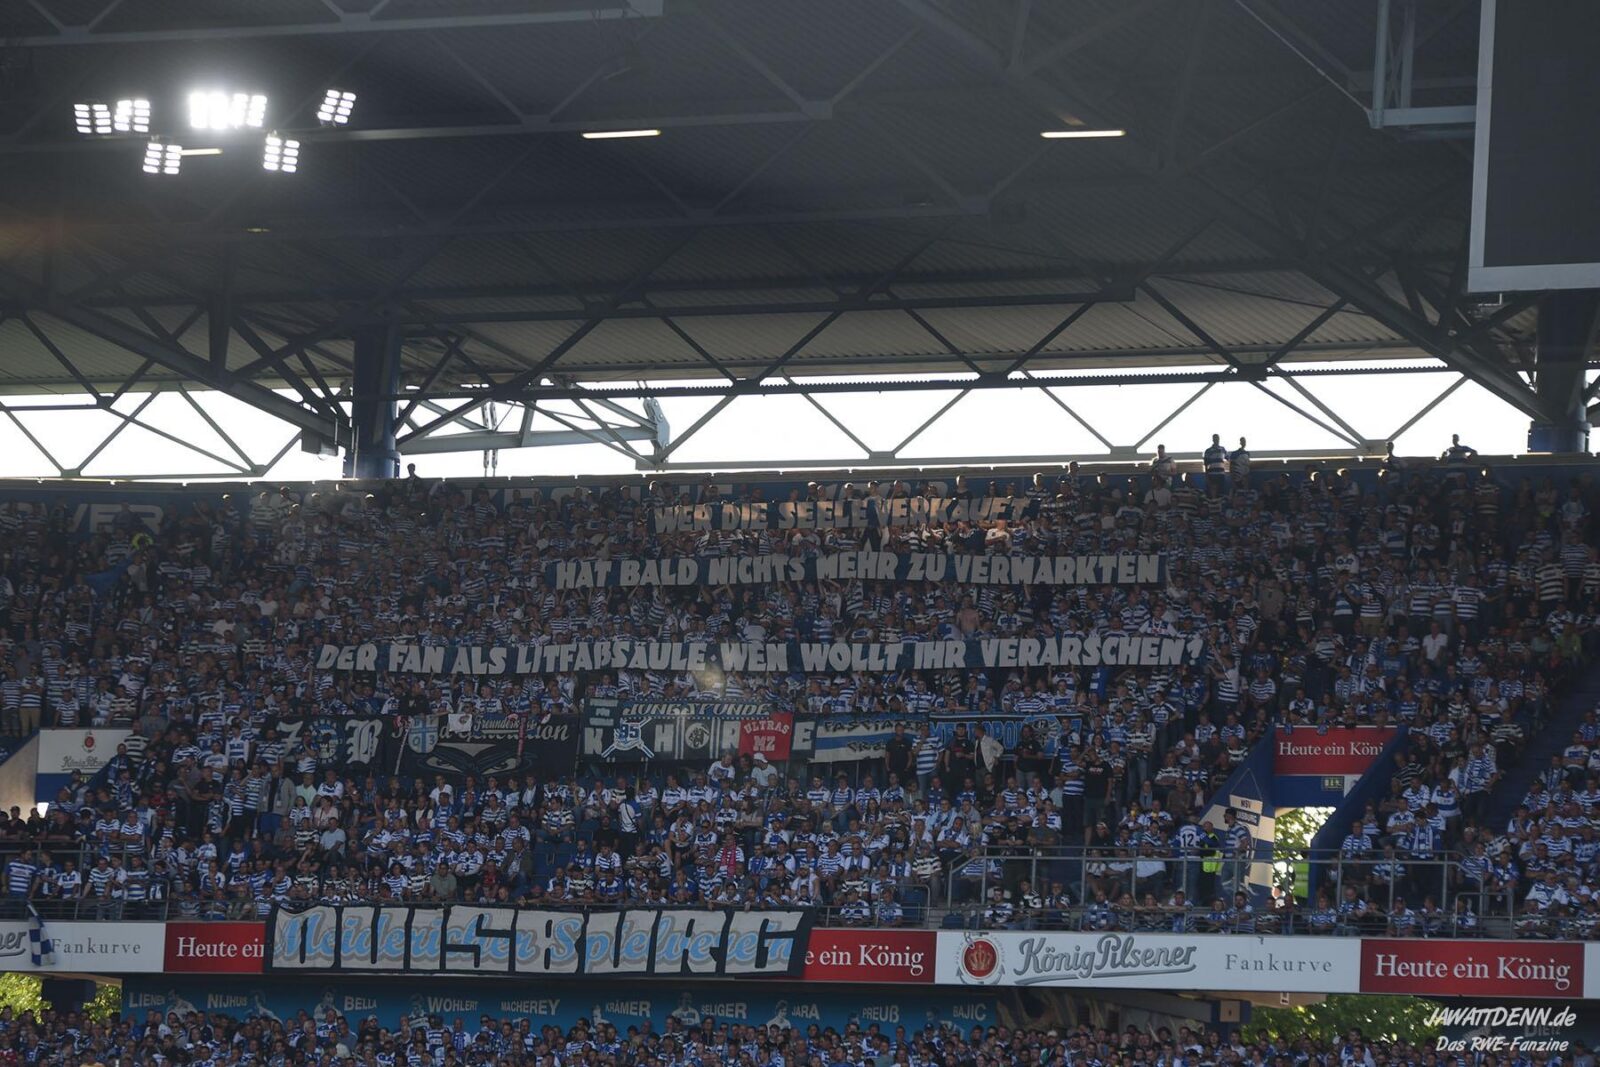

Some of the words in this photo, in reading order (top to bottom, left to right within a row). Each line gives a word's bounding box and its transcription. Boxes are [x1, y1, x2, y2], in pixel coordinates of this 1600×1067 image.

[655, 505, 712, 534] WER
[721, 503, 768, 530] DIE
[779, 499, 868, 529] SEELE
[877, 496, 1030, 526] VERKAUFT
[556, 559, 611, 589] HAT
[619, 558, 698, 586] BALD
[708, 553, 806, 585] NICHTS
[816, 550, 898, 580] MEHR
[906, 553, 946, 581] ZU
[954, 554, 1159, 584] VERMARKTEN
[316, 643, 376, 671] DER
[388, 643, 445, 674] FAN
[451, 644, 507, 675] ALS
[720, 641, 788, 672] WEN
[800, 641, 904, 673] WOLLT
[914, 640, 966, 669] IHR
[981, 636, 1203, 668] VERARSCHEN?
[743, 719, 791, 735] ULTRAS
[753, 735, 776, 752] MZ
[1279, 742, 1321, 756] Heute
[1324, 743, 1345, 756] ein
[1182, 833, 1194, 847] 12
[51, 937, 141, 954] Fankurve
[176, 936, 238, 958] Heute
[272, 905, 804, 974] DUISBURG
[819, 946, 851, 966] ein
[858, 944, 924, 976] König
[1225, 953, 1333, 972] Fankurve
[1375, 954, 1448, 978] Heute
[1453, 957, 1489, 979] ein
[1497, 956, 1571, 990] König
[344, 995, 378, 1011] BELLA
[428, 996, 478, 1013] WOHLERT
[500, 998, 560, 1016] MACHEREY
[605, 998, 652, 1018] KRÄMER
[701, 1002, 748, 1019] SELIGER
[791, 1003, 821, 1020] JARA
[952, 1003, 988, 1021] BAJIC
